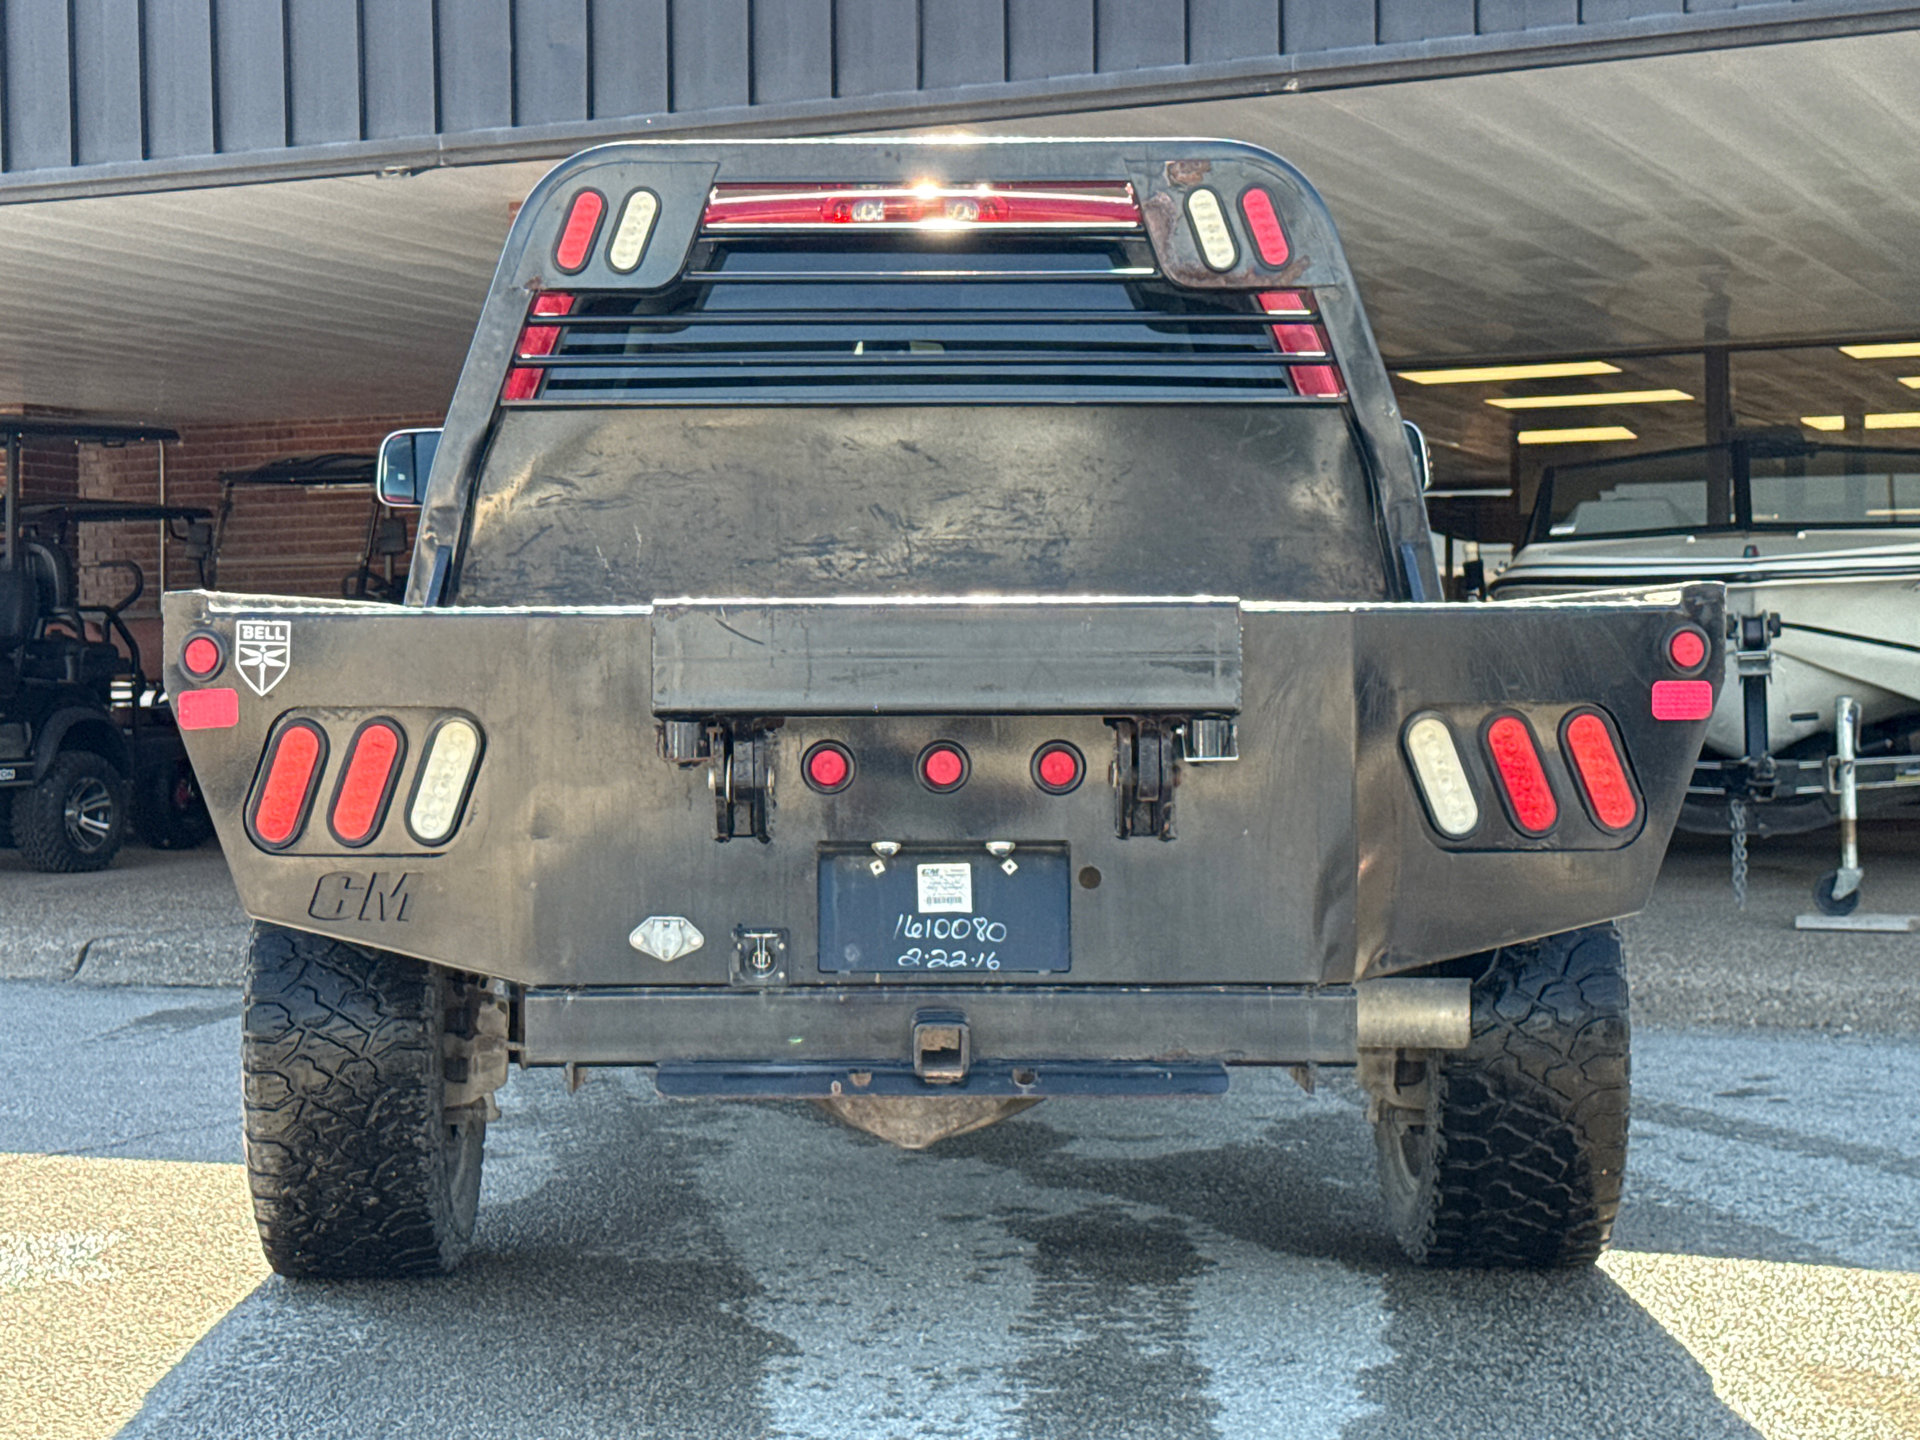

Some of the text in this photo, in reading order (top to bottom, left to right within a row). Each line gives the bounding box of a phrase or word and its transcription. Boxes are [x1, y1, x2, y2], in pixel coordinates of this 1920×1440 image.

[241, 626, 286, 641] BELL
[308, 872, 423, 922] CM
[894, 914, 1007, 942] 1610080
